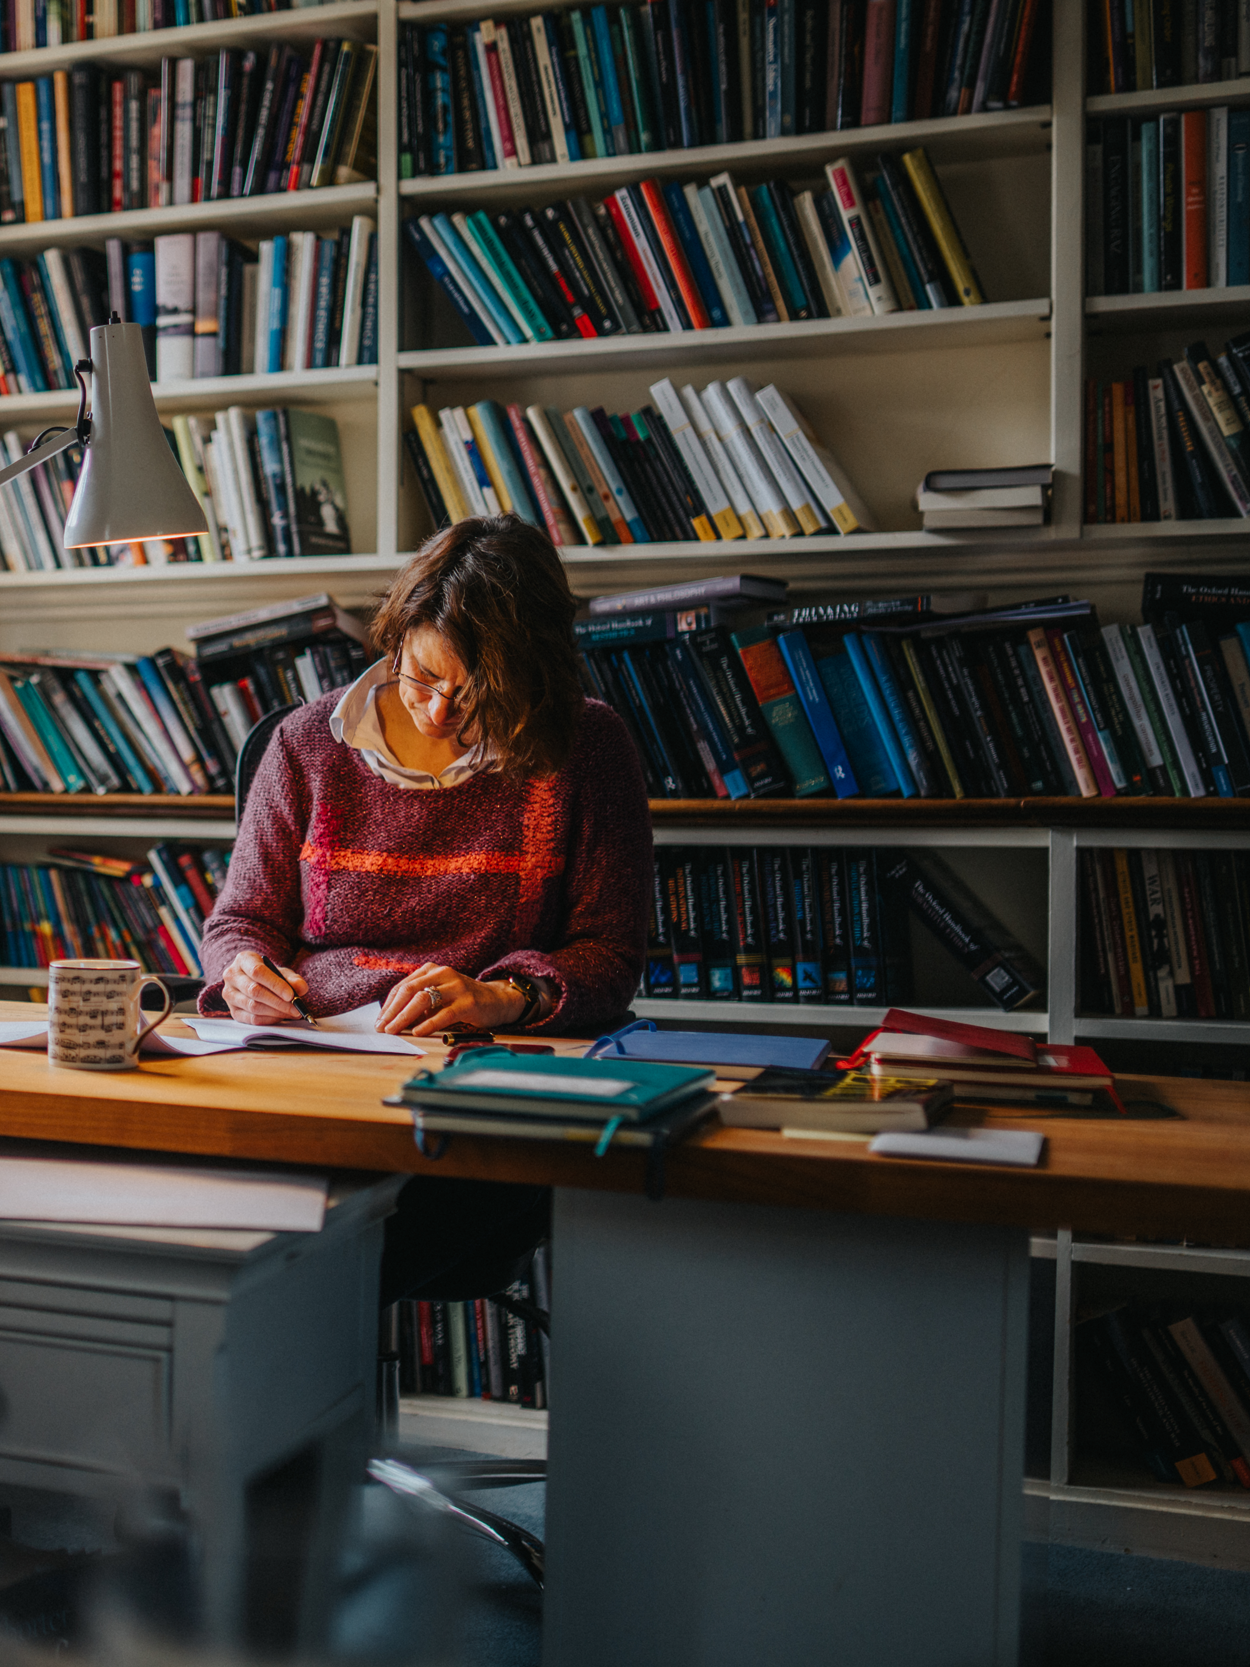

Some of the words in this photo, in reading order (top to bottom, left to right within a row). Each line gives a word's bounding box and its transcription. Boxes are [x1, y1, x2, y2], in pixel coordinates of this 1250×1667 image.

[1108, 155, 1121, 224] ENGAGING
[1163, 162, 1174, 193] Private
[1161, 195, 1173, 231] Wrongs
[633, 595, 650, 606] ART
[656, 585, 706, 603] PHILOSOPHY
[1182, 584, 1195, 593] The
[1198, 585, 1228, 596] Oxford
[1190, 593, 1226, 604] ETHICS
[791, 599, 859, 620] THINKING
[1200, 663, 1227, 713] PROPERTY
[667, 877, 678, 923] RELATIONS
[675, 866, 688, 931] INTERNATIONAL
[1146, 873, 1160, 906] WAR
[913, 877, 929, 894] The
[923, 890, 948, 916] Oxford
[941, 910, 973, 945] Handbook
[966, 940, 981, 955] of
[435, 1322, 445, 1346] WAR
